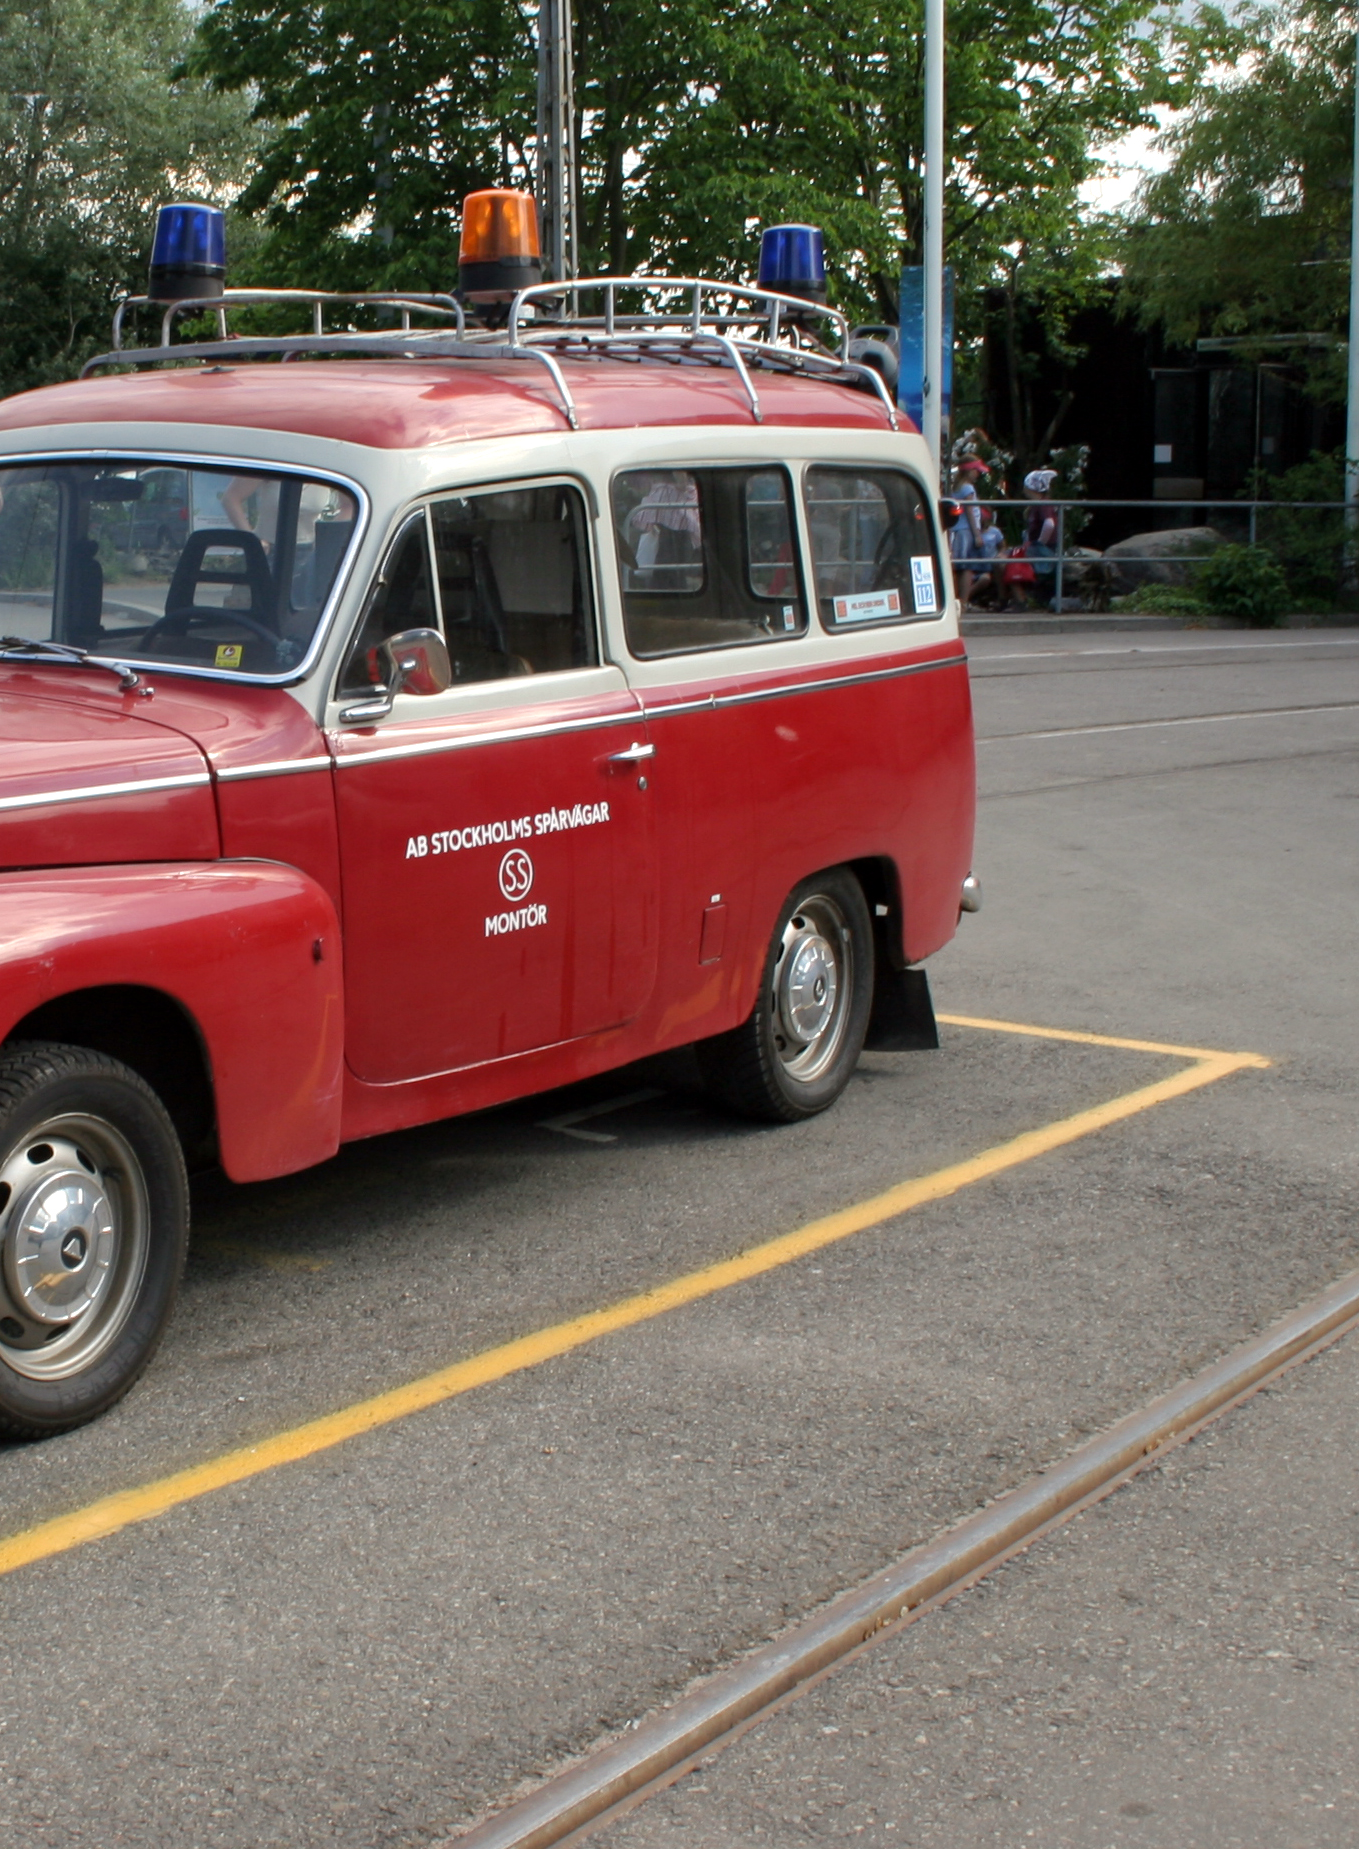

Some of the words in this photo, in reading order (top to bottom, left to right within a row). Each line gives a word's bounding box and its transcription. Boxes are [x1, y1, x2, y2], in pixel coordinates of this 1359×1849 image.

[917, 586, 933, 605] 112
[405, 835, 429, 859] AB
[430, 816, 533, 855] STOCKHOLMS
[534, 801, 611, 835] SPÅRVÄGAR
[504, 857, 529, 893] SS
[484, 903, 548, 938] MONTÖR
